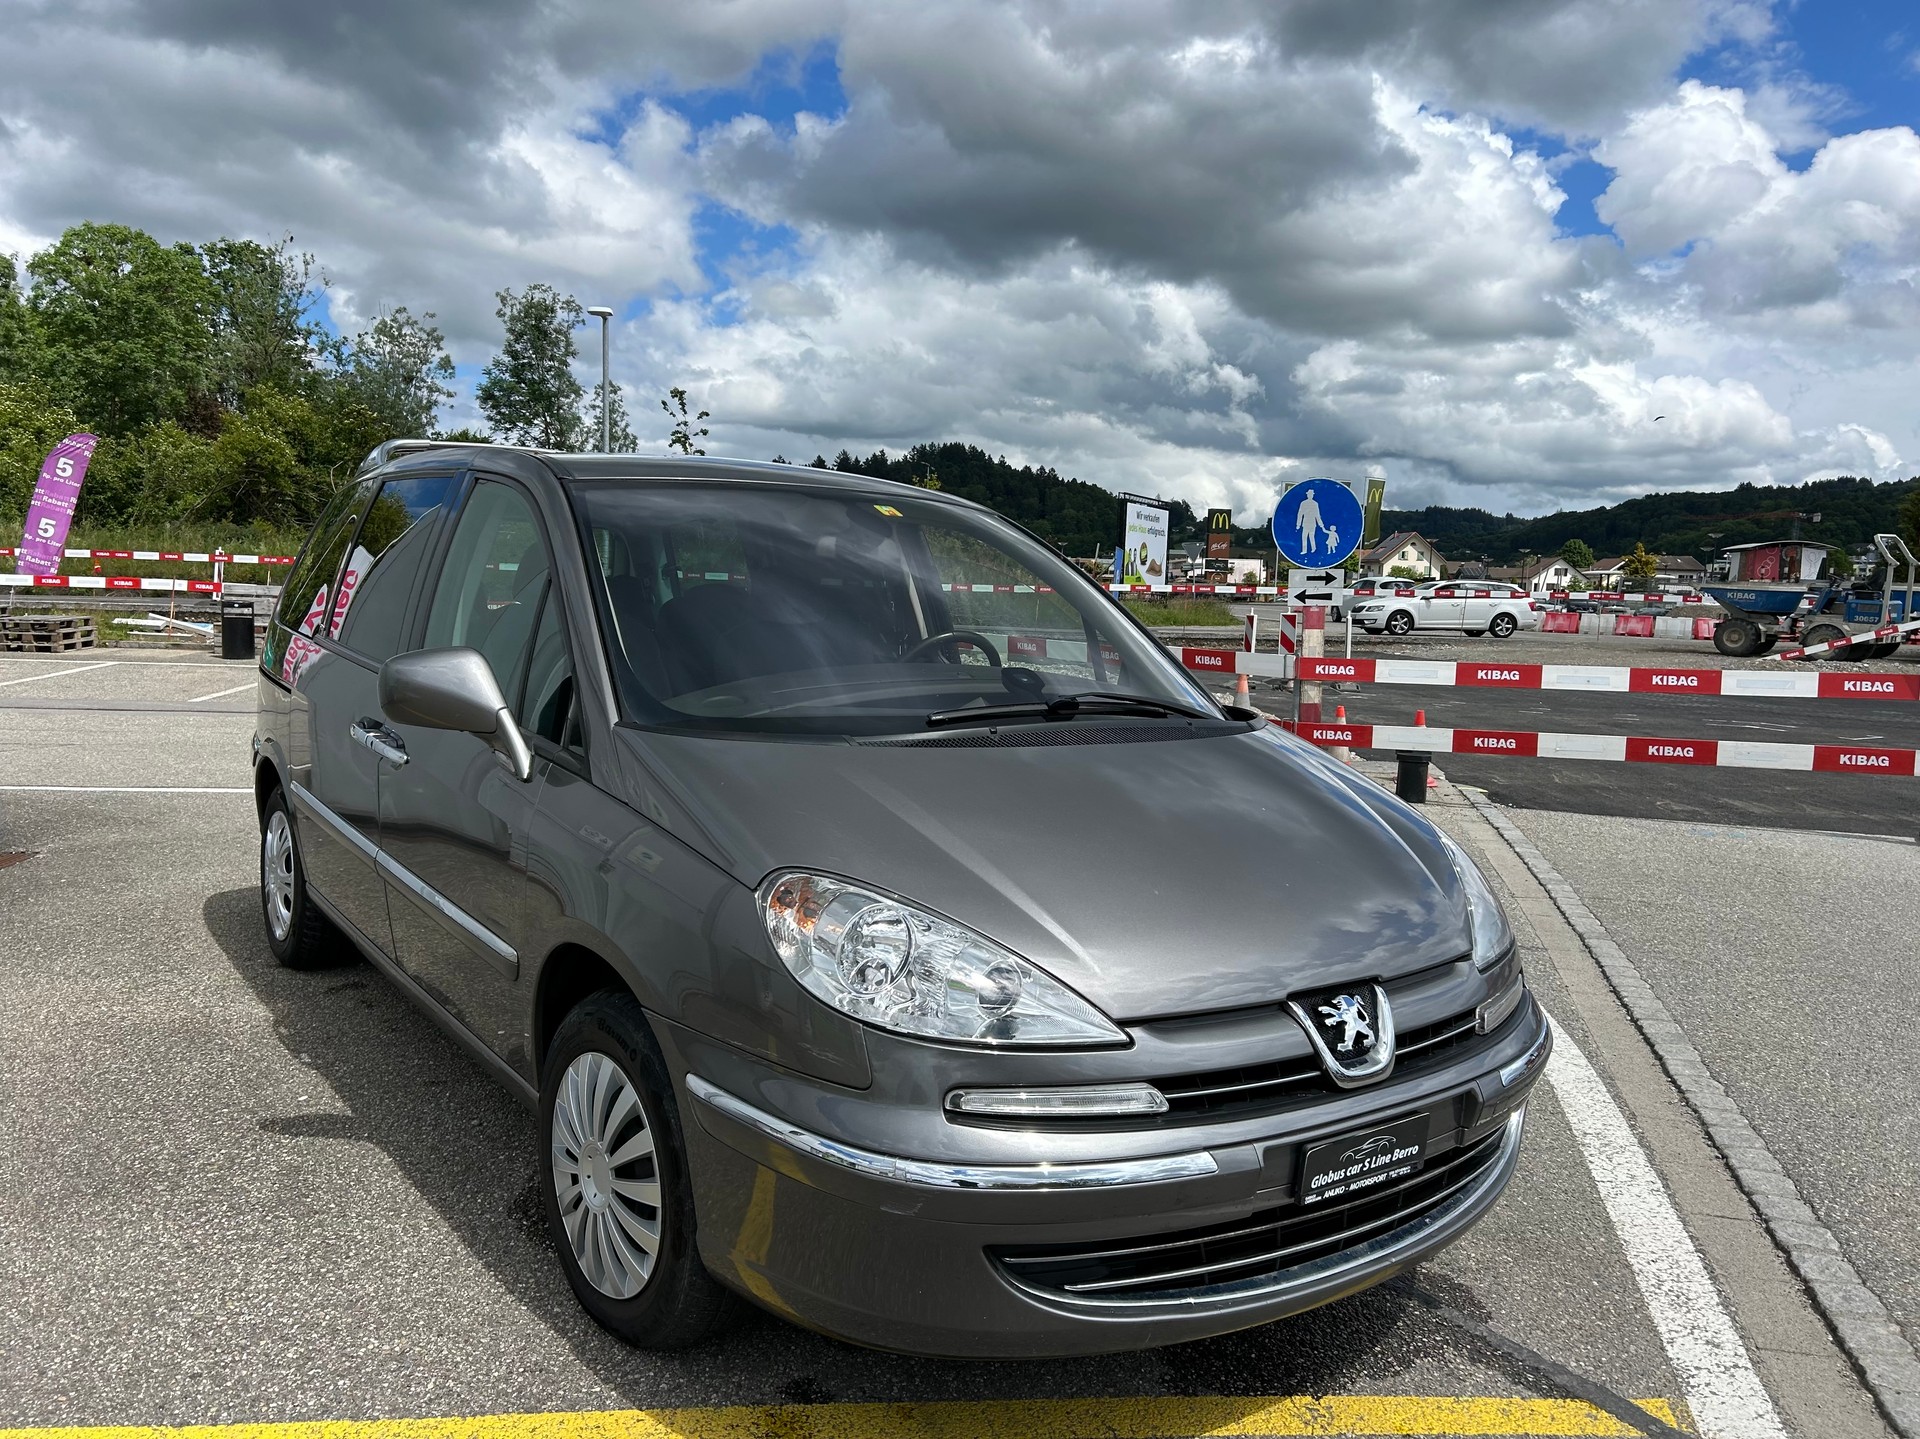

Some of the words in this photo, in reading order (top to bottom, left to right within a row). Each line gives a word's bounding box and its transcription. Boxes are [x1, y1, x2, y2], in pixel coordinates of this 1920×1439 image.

[55, 457, 74, 477] 5
[42, 495, 69, 508] Rabatt
[38, 517, 56, 538] 5
[25, 555, 52, 567] Rabatt
[1727, 591, 1756, 600] KIBAG
[1017, 642, 1037, 651] KIBAG
[1195, 655, 1222, 665] KIBAG
[1315, 665, 1355, 676] KIBAG
[1477, 669, 1520, 681] KIBAG
[1652, 675, 1698, 687] KIBAG
[1844, 680, 1894, 693] KIBAG
[1313, 729, 1352, 741] KIBAG
[1474, 736, 1516, 749] KIBAG
[1648, 745, 1694, 758] KIBAG
[1839, 754, 1889, 767] KIBAG
[1311, 1169, 1345, 1189] Globus
[1346, 1163, 1363, 1176] car
[1362, 1158, 1371, 1171] S
[1370, 1153, 1392, 1169] Line
[1392, 1145, 1419, 1161] Berro
[1349, 1172, 1388, 1191] MOTORSPORT
